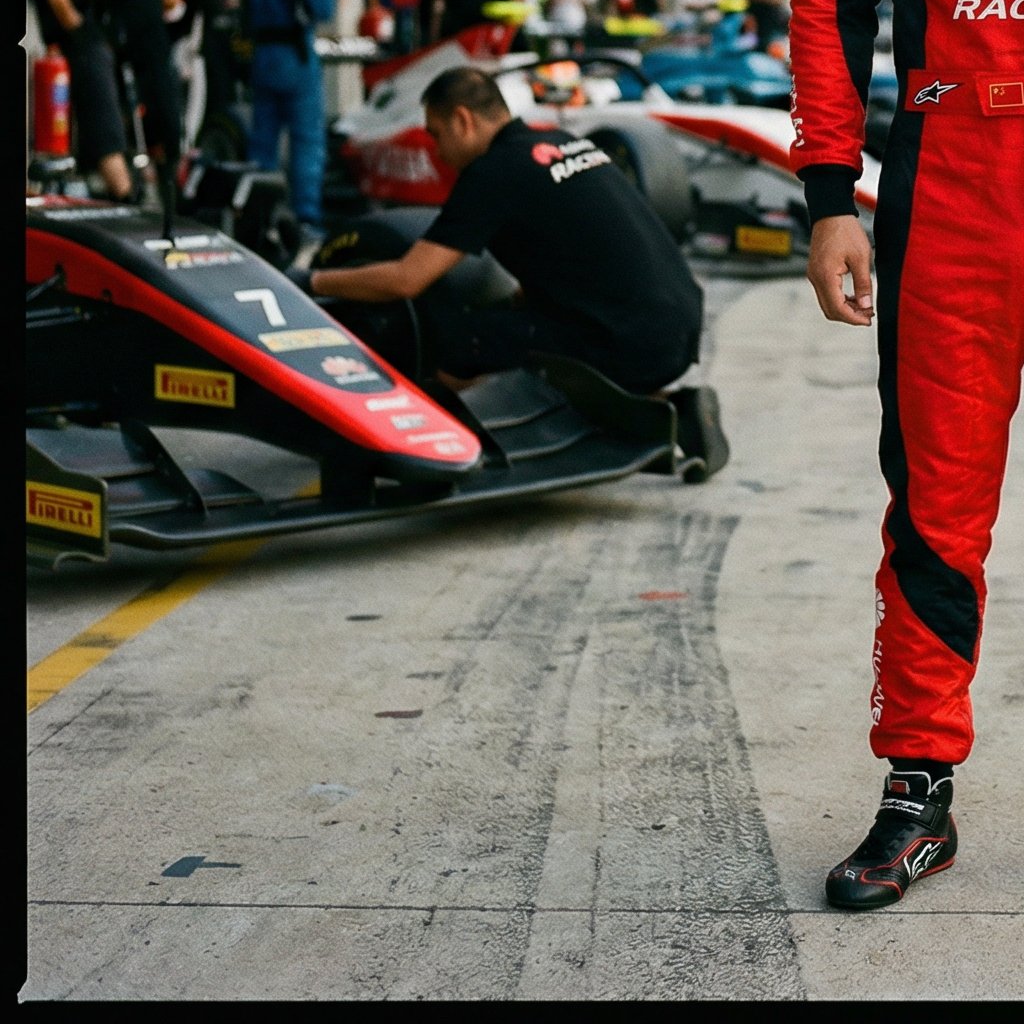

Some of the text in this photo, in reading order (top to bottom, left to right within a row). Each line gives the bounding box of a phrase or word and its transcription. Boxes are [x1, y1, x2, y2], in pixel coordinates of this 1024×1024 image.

[233, 288, 287, 326] 7
[161, 371, 228, 402] PIRELLI
[28, 488, 94, 528] PIRELLI
